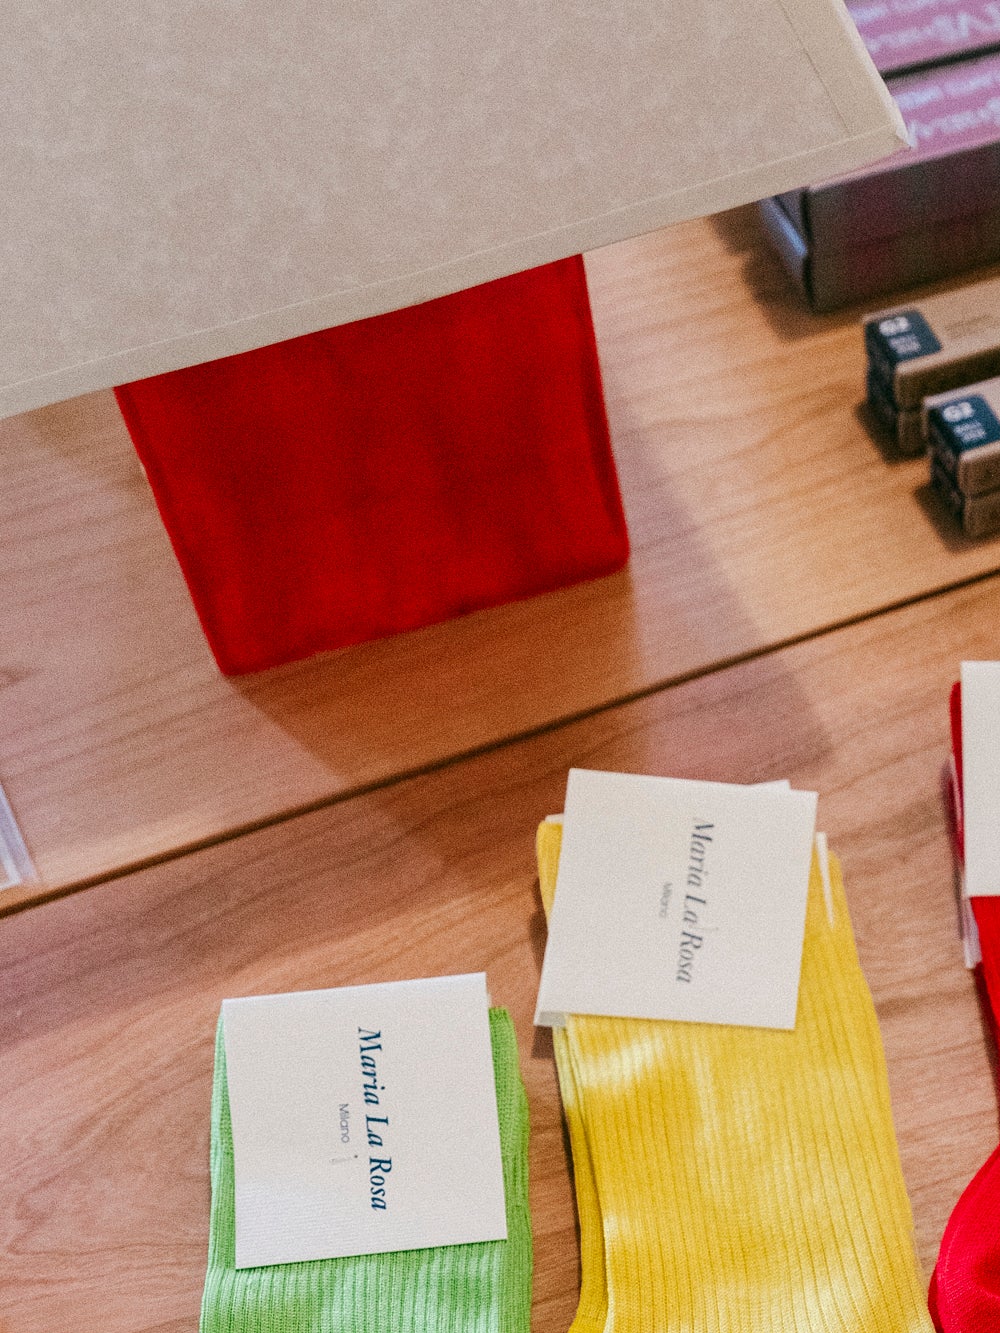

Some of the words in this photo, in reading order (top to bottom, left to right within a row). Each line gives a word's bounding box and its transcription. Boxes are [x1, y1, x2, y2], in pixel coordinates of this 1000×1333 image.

[686, 817, 715, 887] Maria
[682, 894, 706, 924] La
[676, 930, 704, 984] Rosa
[358, 1026, 386, 1106] Maria
[338, 1103, 350, 1144] Milano
[365, 1113, 389, 1148] La
[369, 1156, 392, 1211] Rosa
